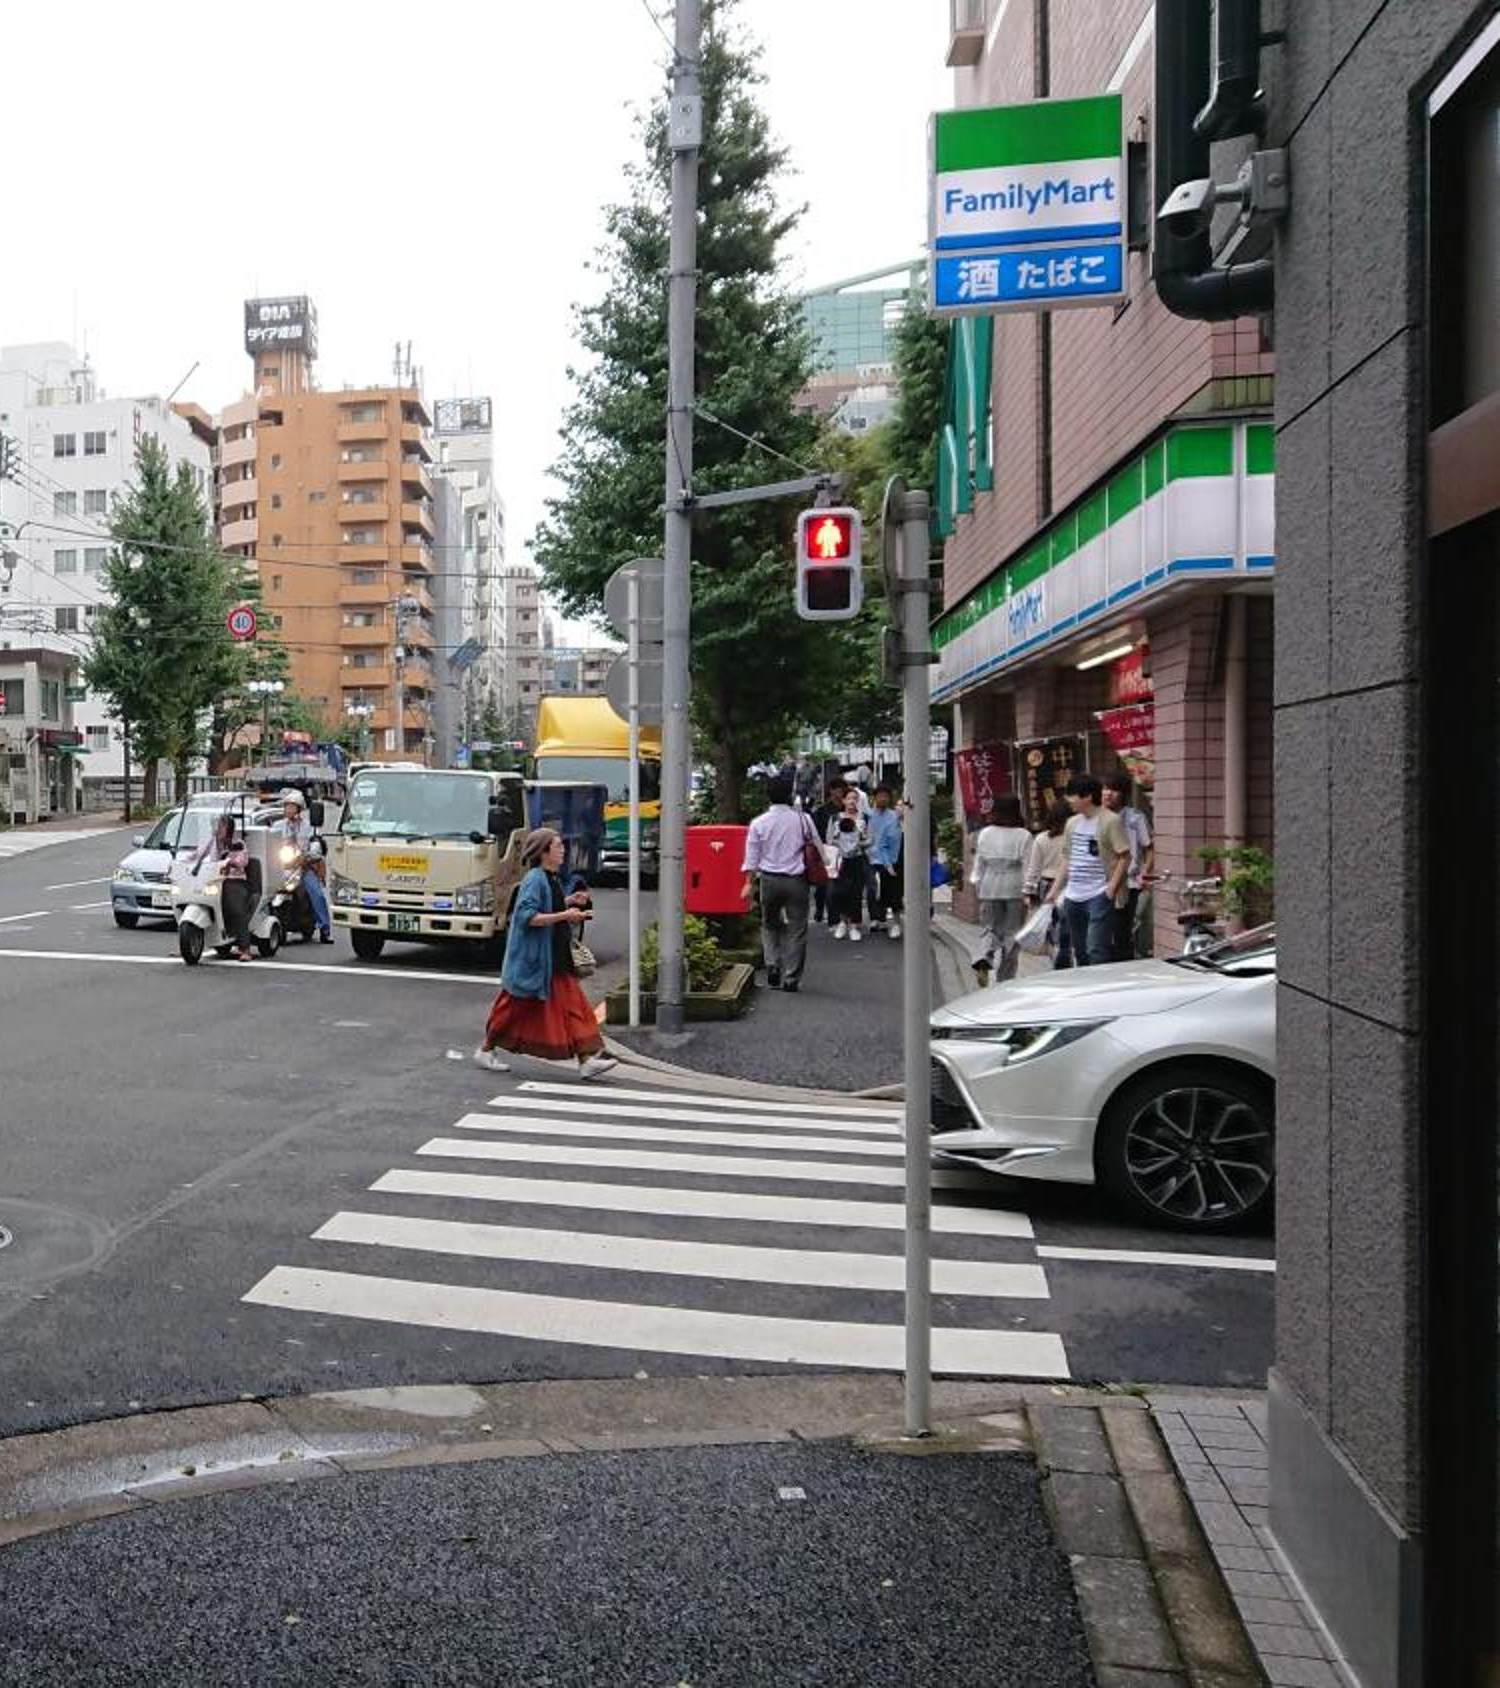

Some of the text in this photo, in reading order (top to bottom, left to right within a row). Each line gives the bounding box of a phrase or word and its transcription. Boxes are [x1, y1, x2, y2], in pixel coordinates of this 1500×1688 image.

[945, 177, 1115, 215] FamilyMart
[958, 256, 1107, 298] 酒 たばこ
[234, 614, 251, 629] 40
